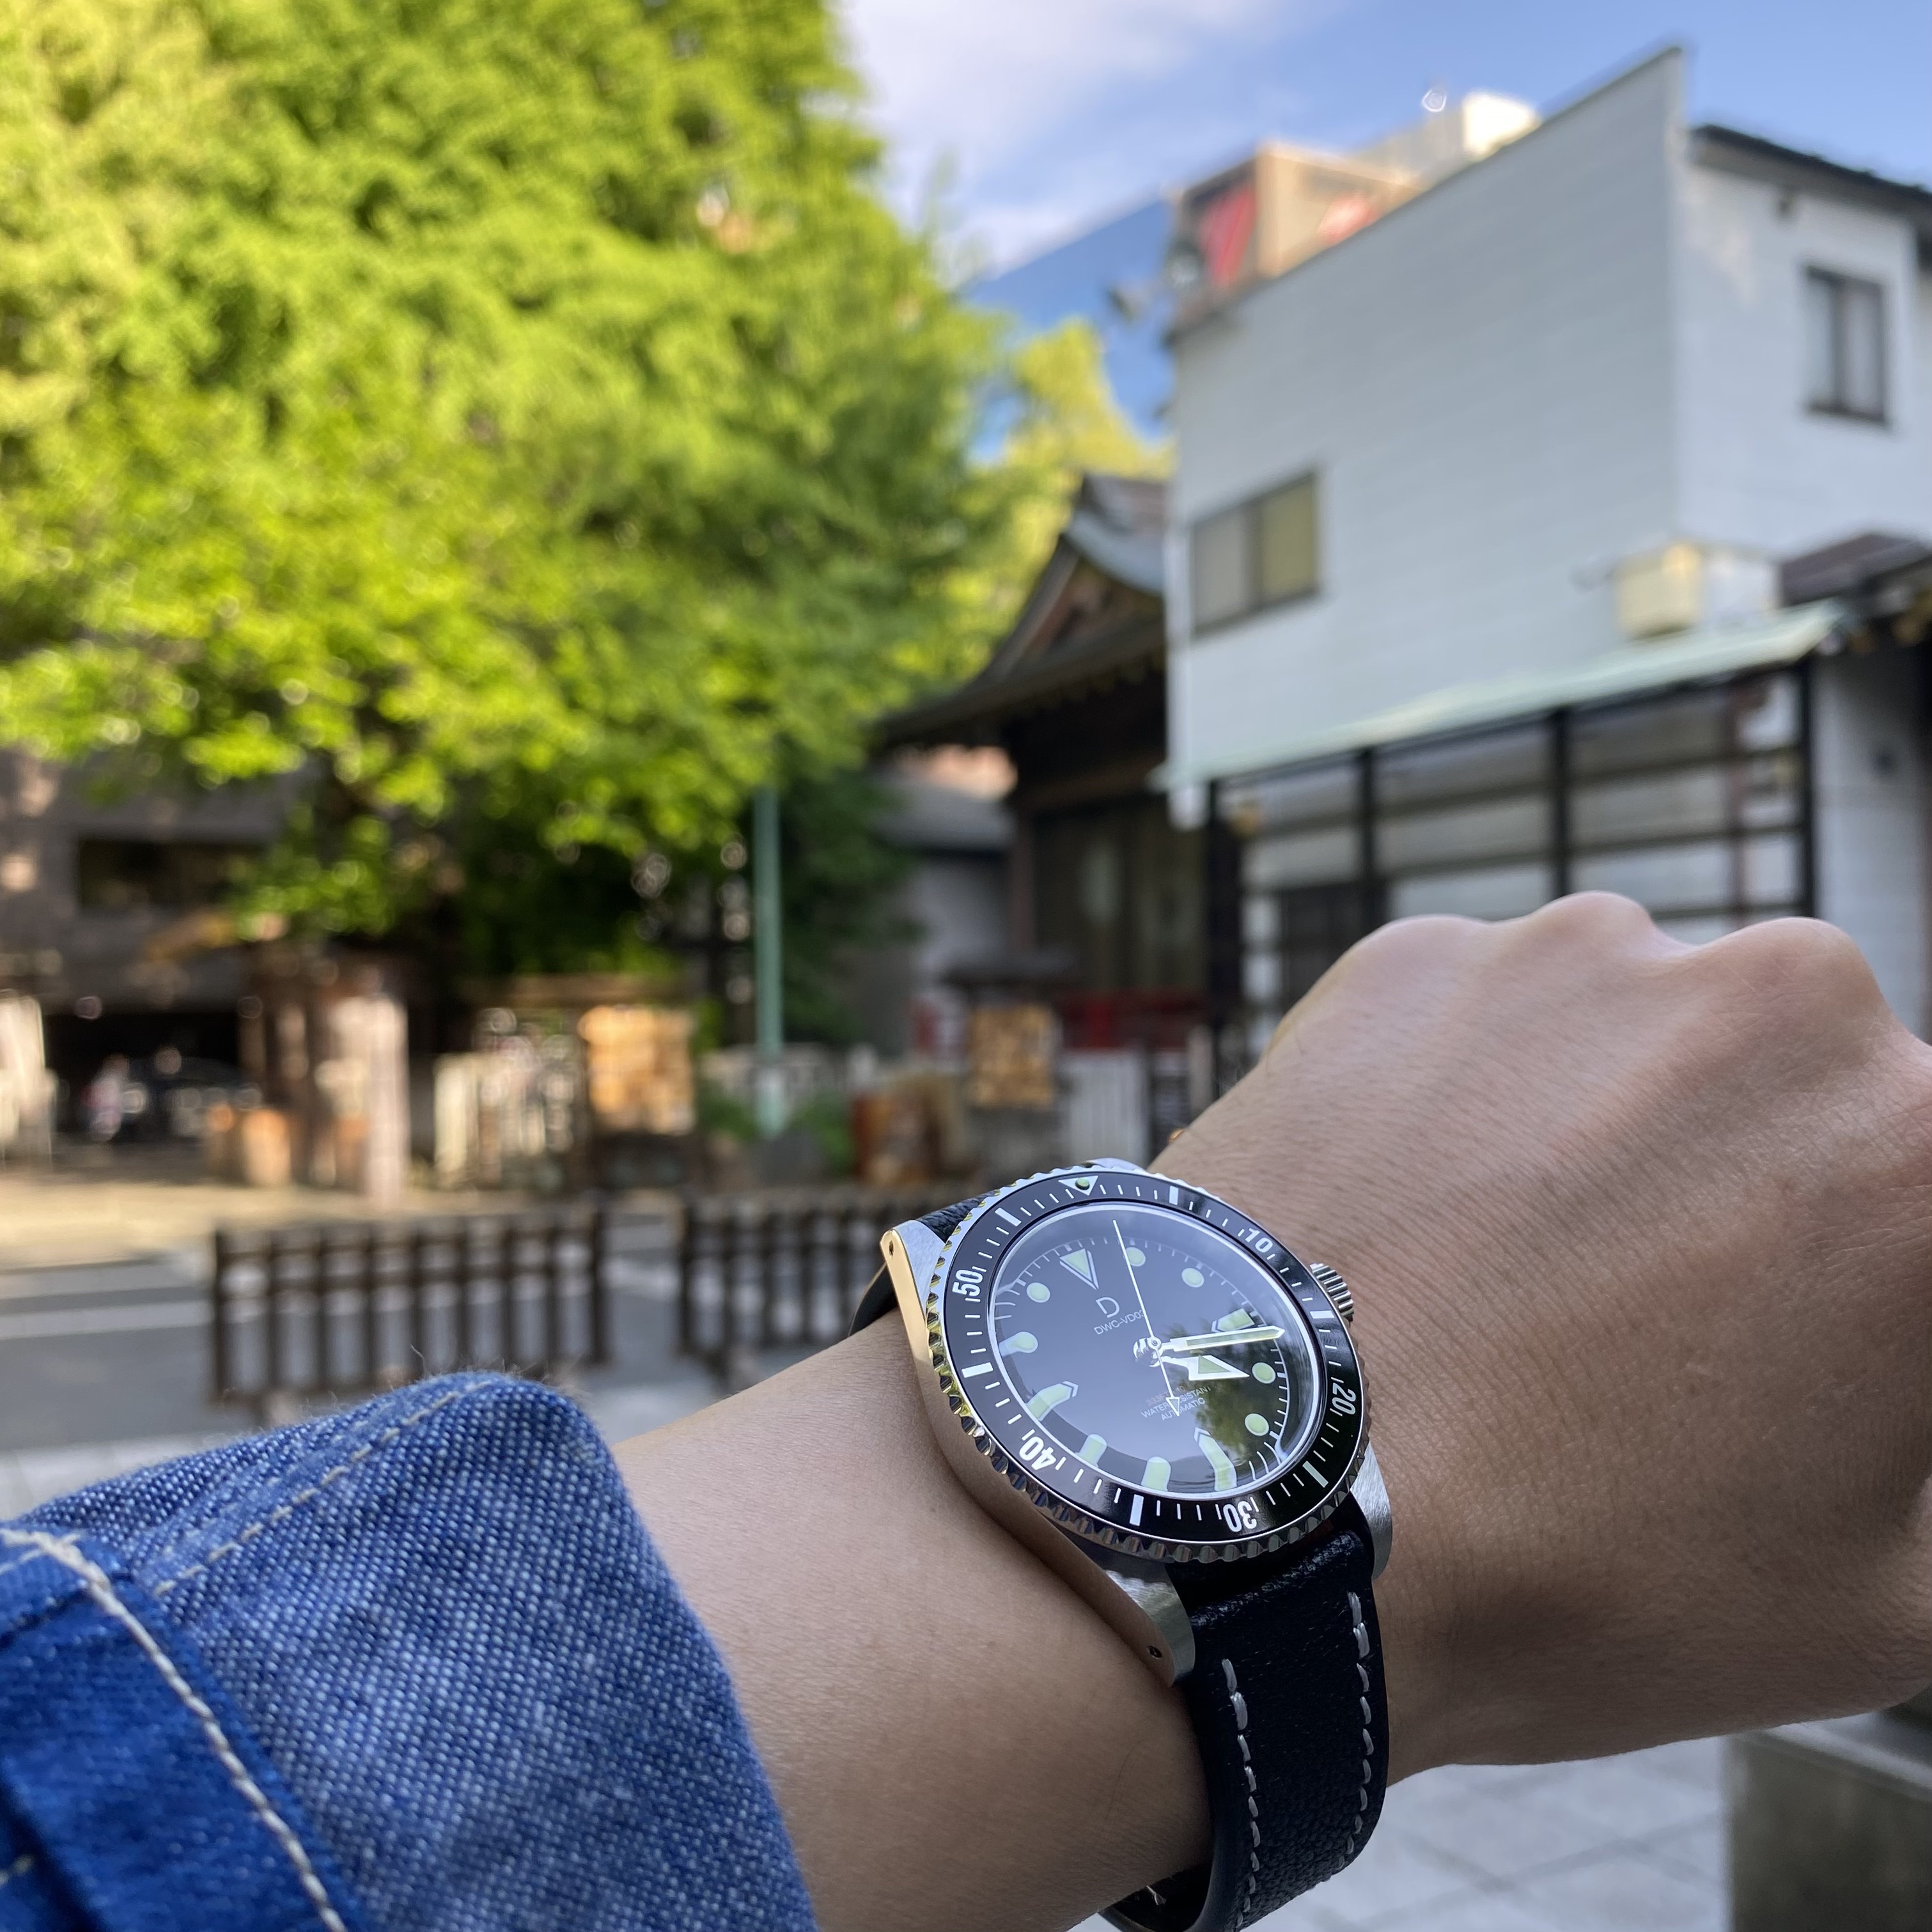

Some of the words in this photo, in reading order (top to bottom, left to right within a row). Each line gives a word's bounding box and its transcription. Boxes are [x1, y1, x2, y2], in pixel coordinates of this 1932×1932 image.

[1245, 1228, 1273, 1252] 10
[952, 1270, 983, 1296] 50
[1141, 1402, 1171, 1418] WATER
[1332, 1382, 1356, 1414] 20
[1019, 1436, 1057, 1470] 40
[1223, 1501, 1257, 1532] 30
